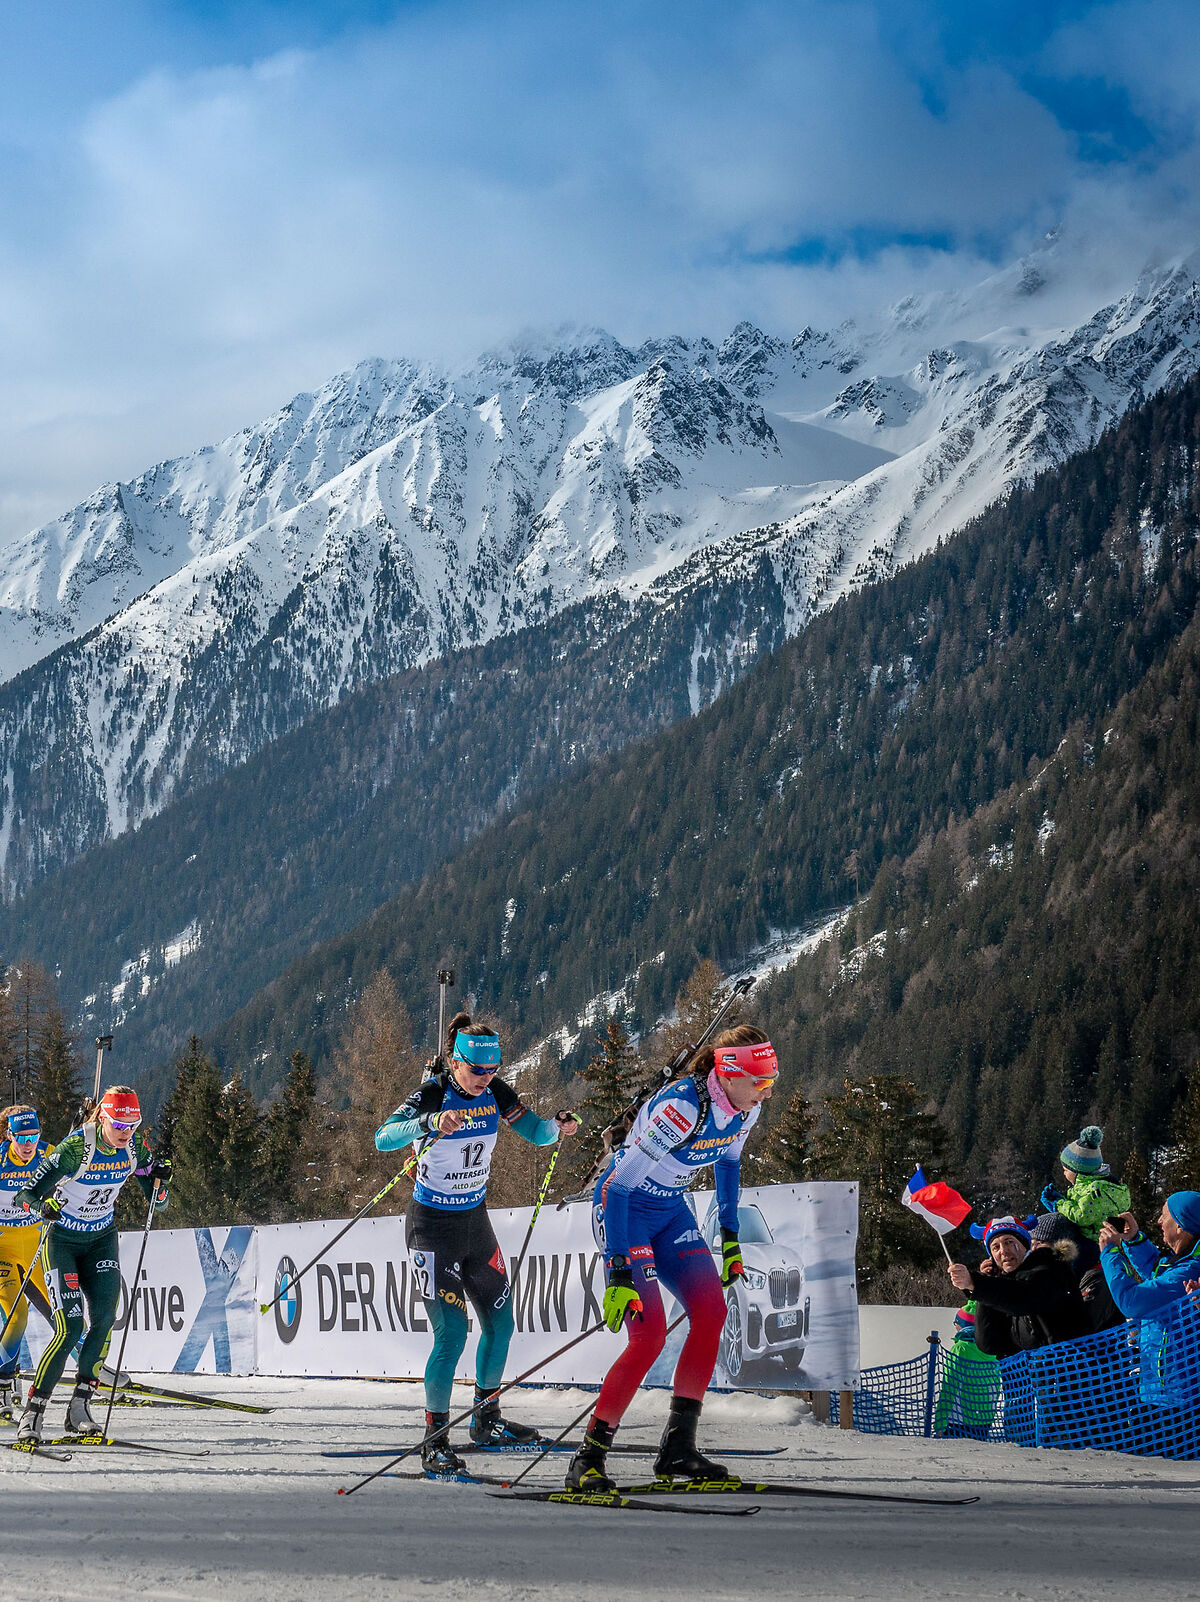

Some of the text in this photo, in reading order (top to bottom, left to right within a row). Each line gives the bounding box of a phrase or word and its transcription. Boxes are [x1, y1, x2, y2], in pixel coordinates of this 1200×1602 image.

[461, 1141, 485, 1169] 12
[87, 1188, 113, 1206] 23
[316, 1262, 382, 1332] DER
[51, 1437, 104, 1446] FISCHER
[630, 1482, 742, 1492] FISCHER
[548, 1494, 614, 1505] FISCHER
